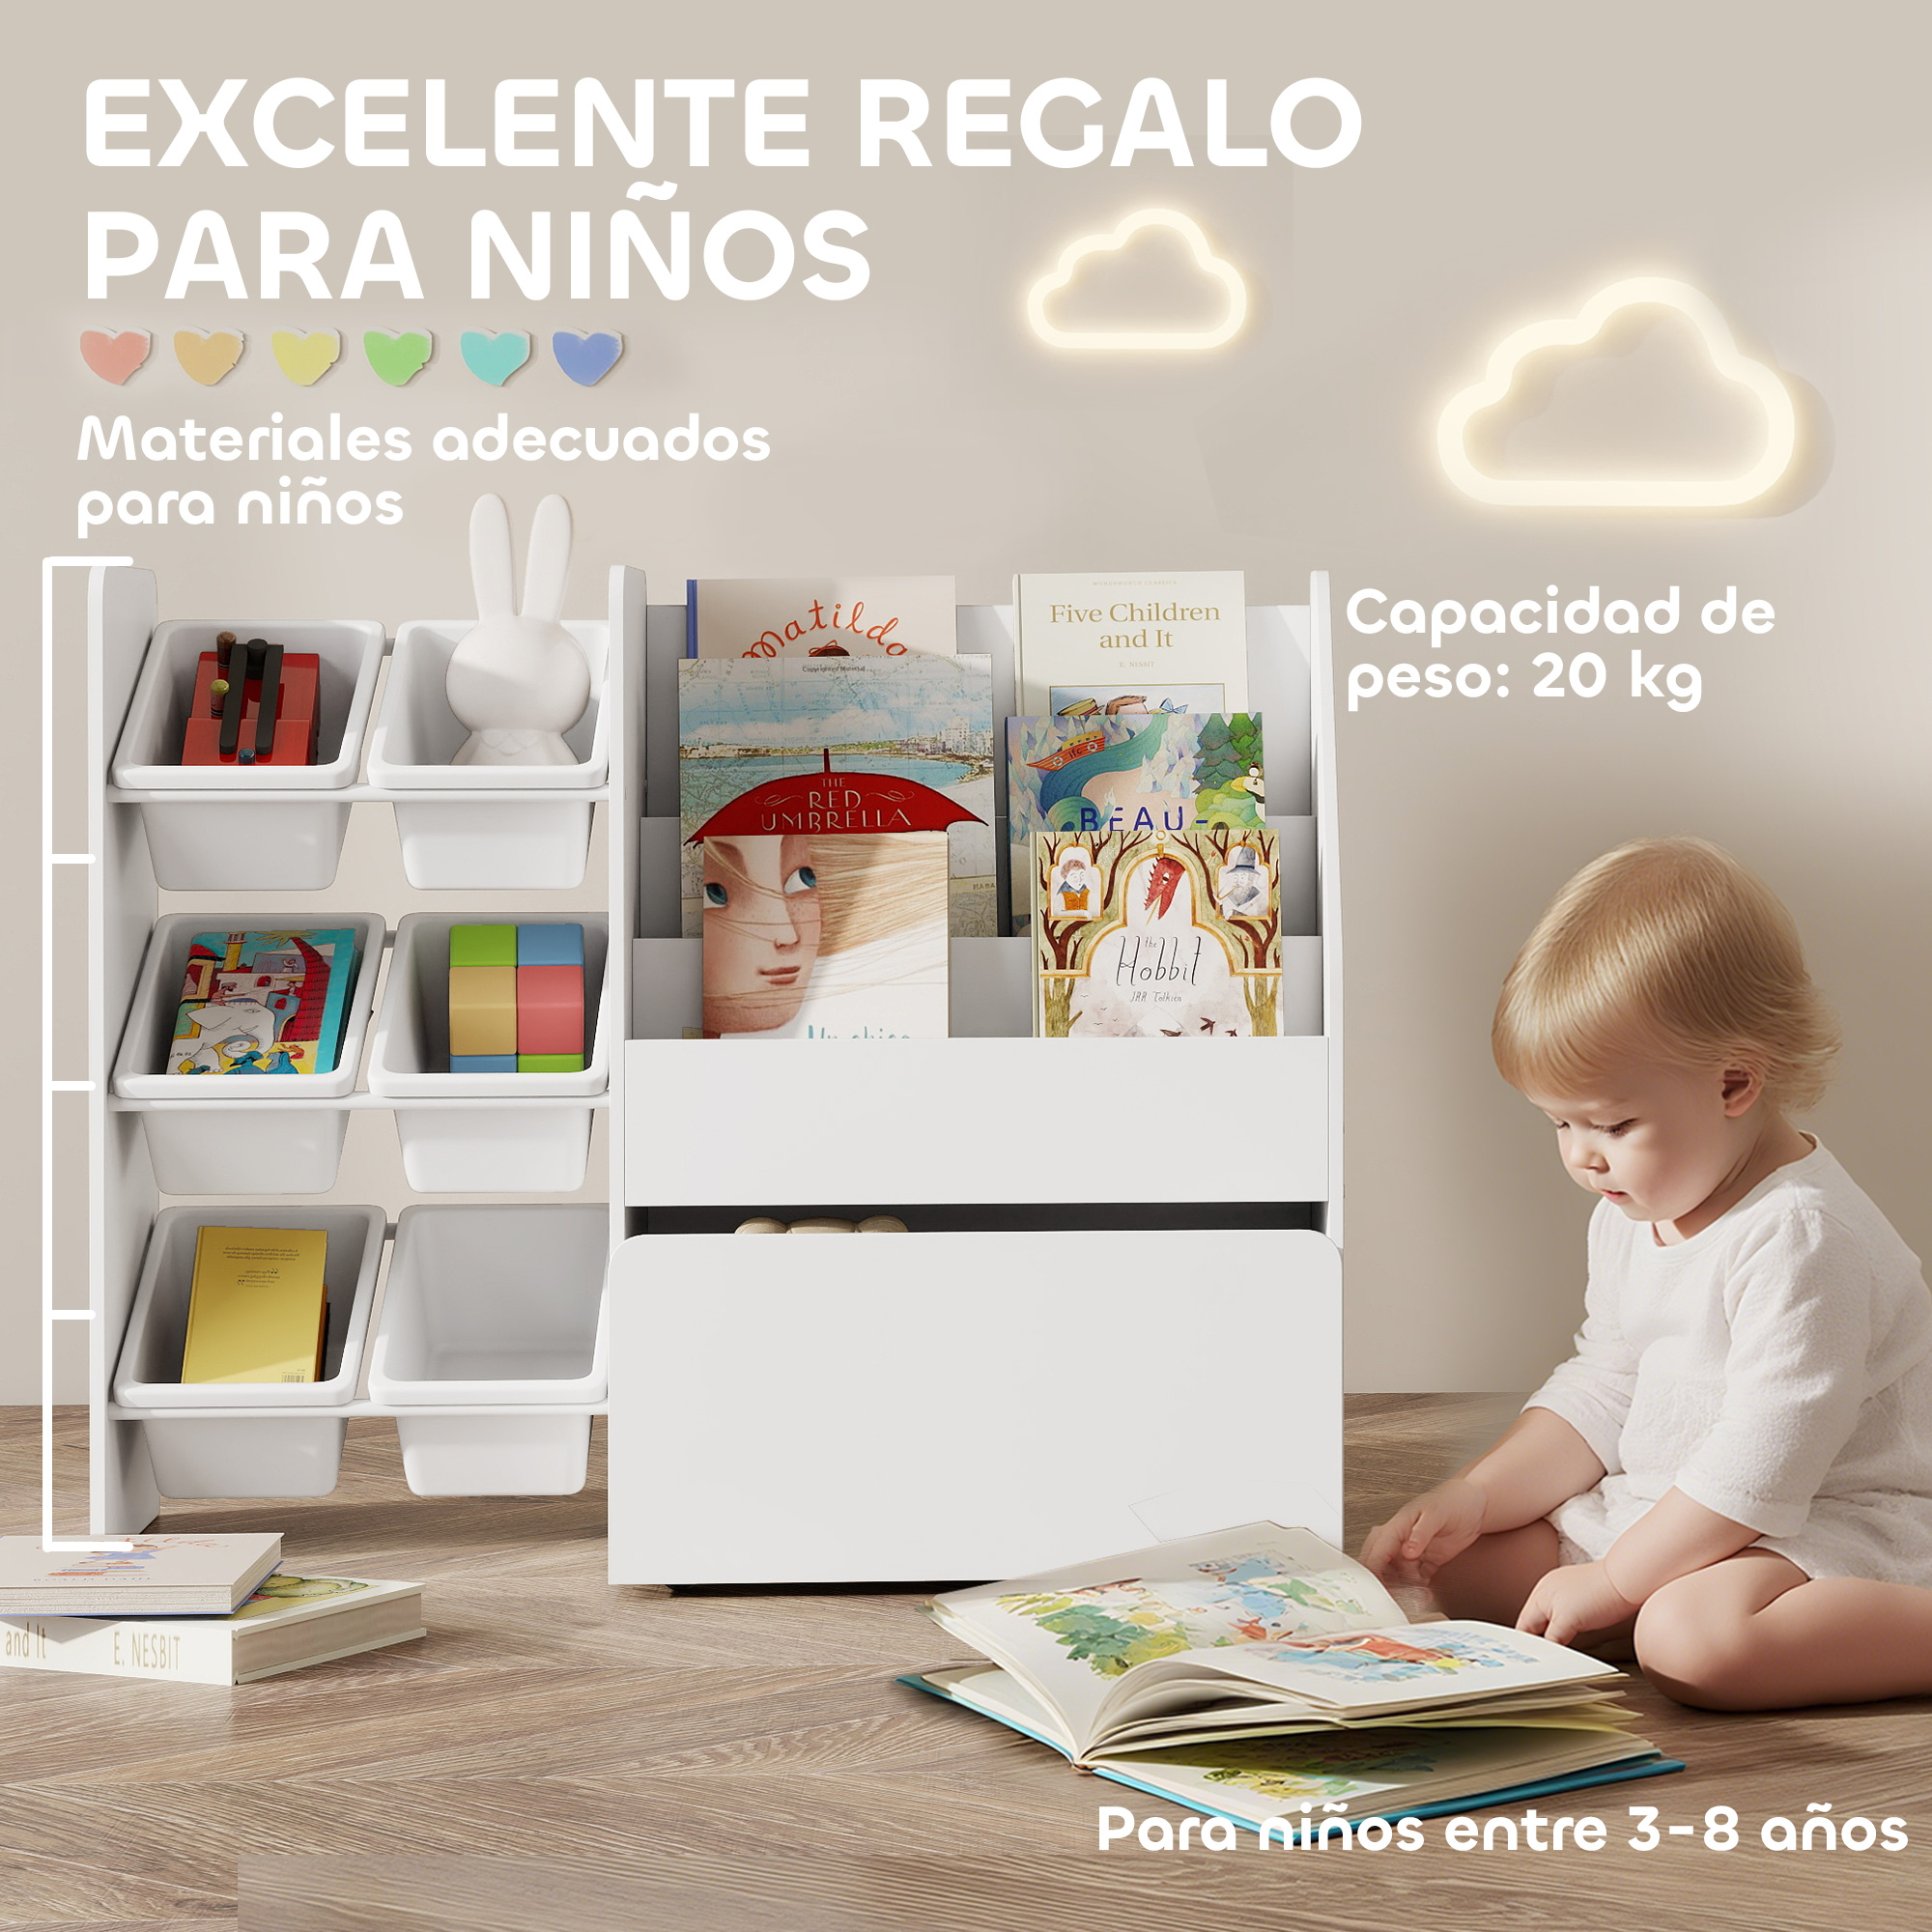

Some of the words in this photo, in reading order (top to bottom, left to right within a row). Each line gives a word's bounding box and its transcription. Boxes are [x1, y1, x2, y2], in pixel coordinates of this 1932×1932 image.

[1050, 604, 1102, 623] Five
[1109, 602, 1221, 622] Children
[1099, 629, 1149, 648] and
[1155, 629, 1174, 648] It
[821, 778, 846, 788] THE
[809, 790, 862, 810] RED
[760, 809, 912, 833] UMBRELLA
[1145, 937, 1157, 949] the
[1117, 936, 1202, 986] Hobbit
[1153, 991, 1182, 1003] Tolkien
[6, 1620, 30, 1658] and
[114, 1631, 125, 1666] E.
[131, 1632, 181, 1670] NESBIT
